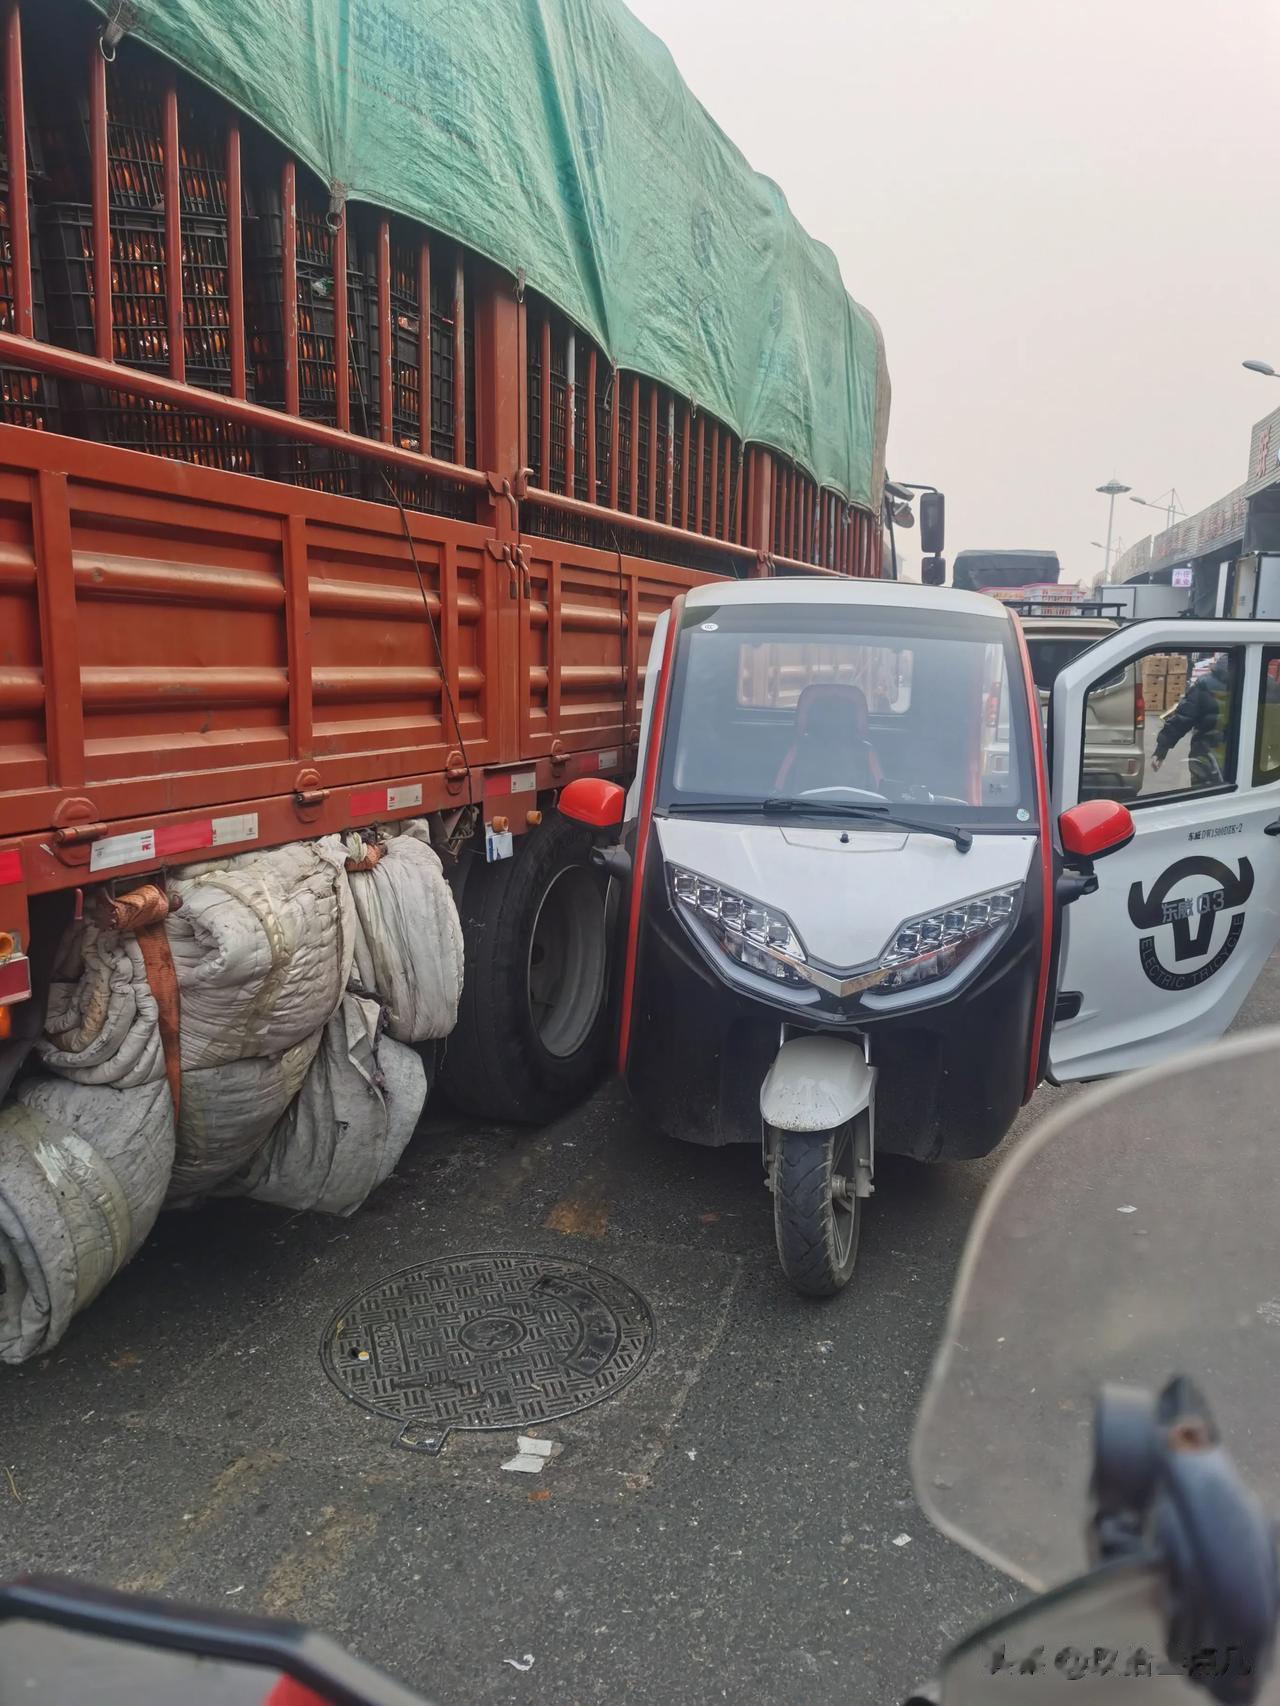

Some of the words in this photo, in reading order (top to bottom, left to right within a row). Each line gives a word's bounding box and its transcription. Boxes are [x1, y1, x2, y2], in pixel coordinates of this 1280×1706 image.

[1161, 896, 1193, 924] 东威
[1197, 890, 1225, 914] Q3
[1140, 938, 1186, 988] ELECTRIC
[1190, 915, 1244, 984] TRICYCLE
